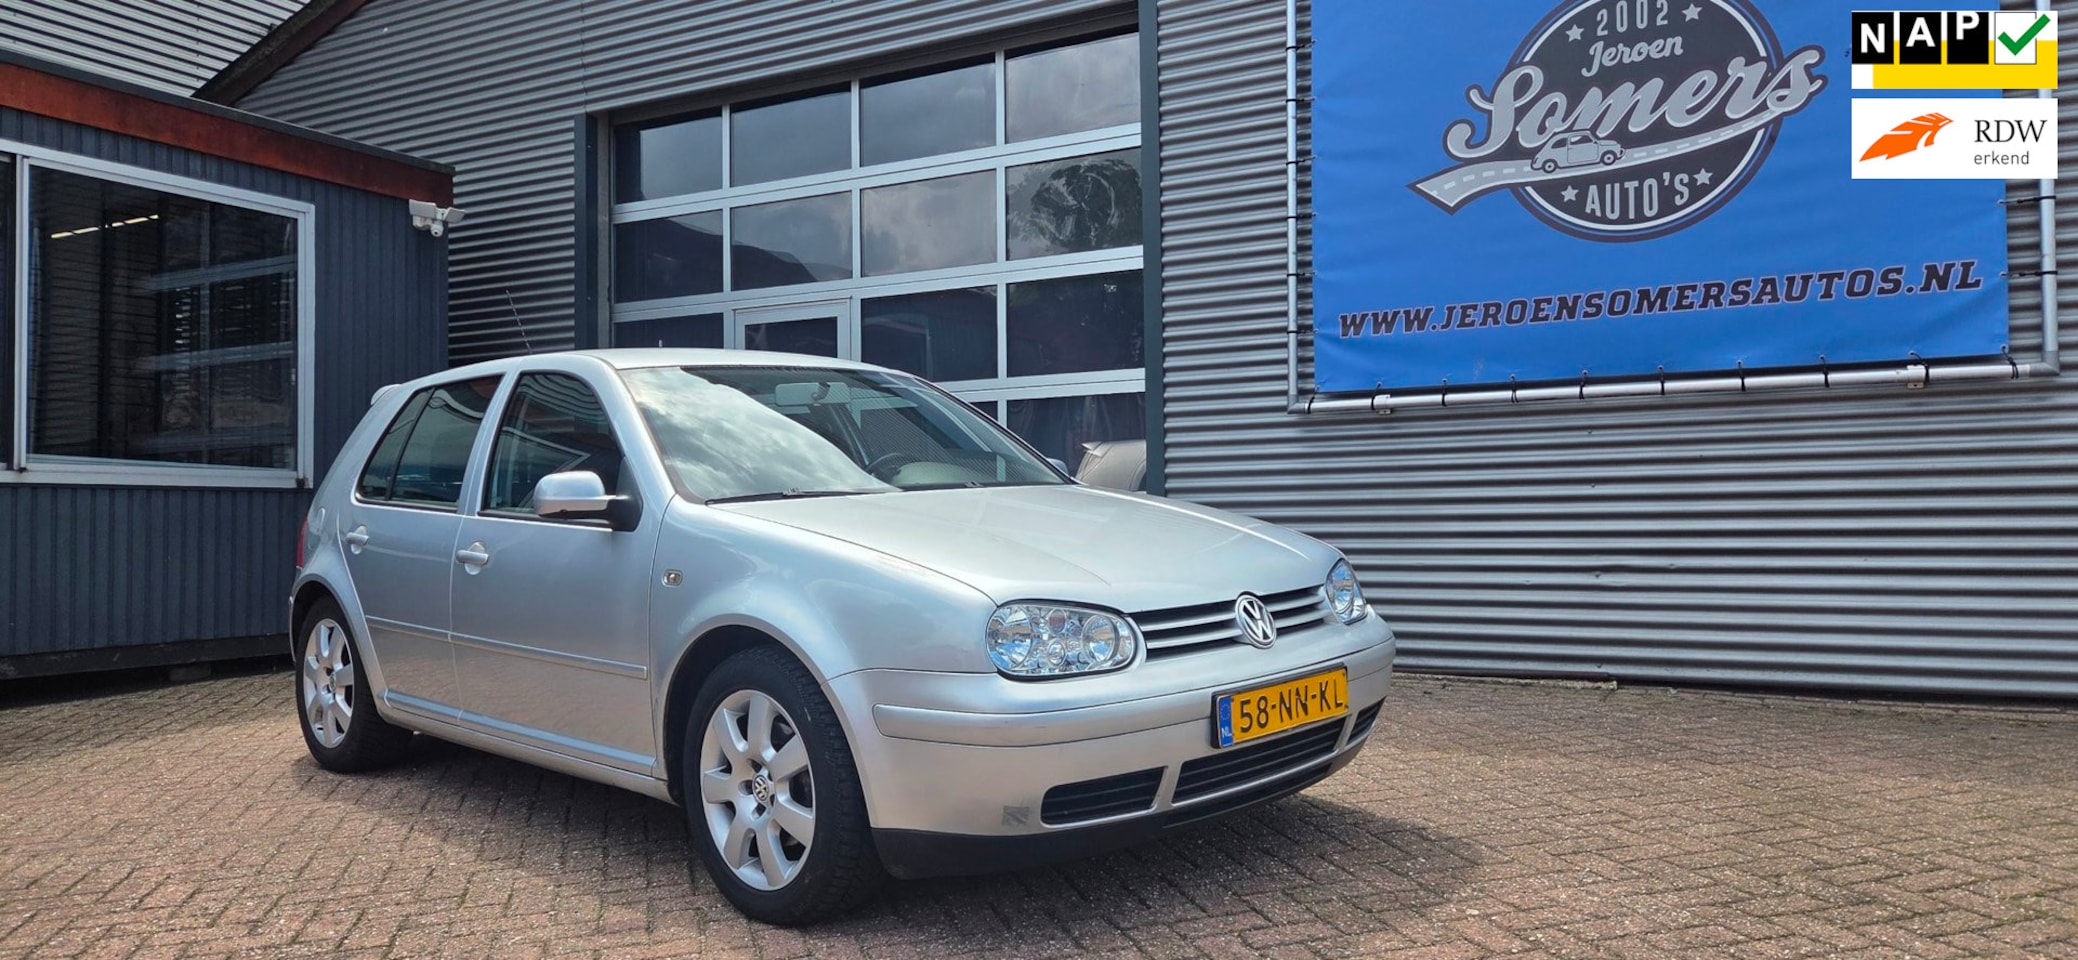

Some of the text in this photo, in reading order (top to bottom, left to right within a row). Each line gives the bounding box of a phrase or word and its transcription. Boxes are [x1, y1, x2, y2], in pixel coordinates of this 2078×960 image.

[1596, 0, 1668, 36] 2002
[1581, 35, 1684, 78] Jeroen
[1446, 49, 1824, 159] Somers
[1585, 172, 1691, 220] AUTO'S
[1339, 260, 1983, 338] WWW.JEROENSOMERSAUTOS.NL
[1236, 596, 1275, 647] VW
[1239, 678, 1343, 733] 58-NN-KL
[1221, 726, 1233, 739] NL
